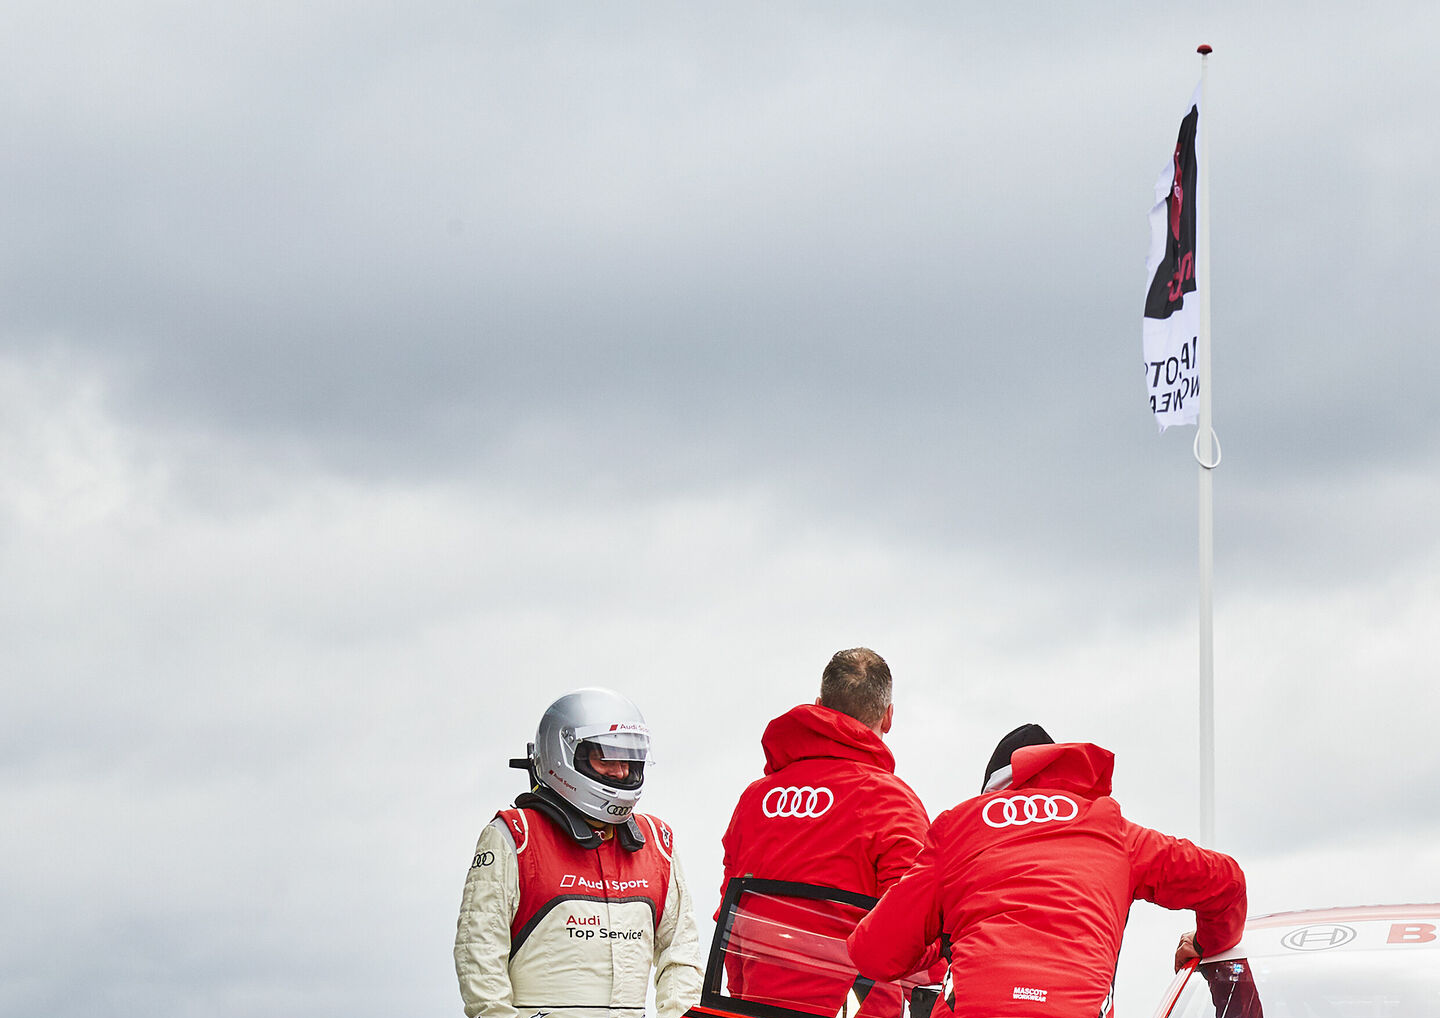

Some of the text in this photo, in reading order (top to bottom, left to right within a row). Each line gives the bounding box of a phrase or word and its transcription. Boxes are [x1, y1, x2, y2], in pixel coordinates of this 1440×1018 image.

[578, 876, 649, 892] Audi Sport
[566, 915, 601, 926] Audi
[566, 927, 595, 940] Top
[1013, 986, 1048, 997] MASCOT
